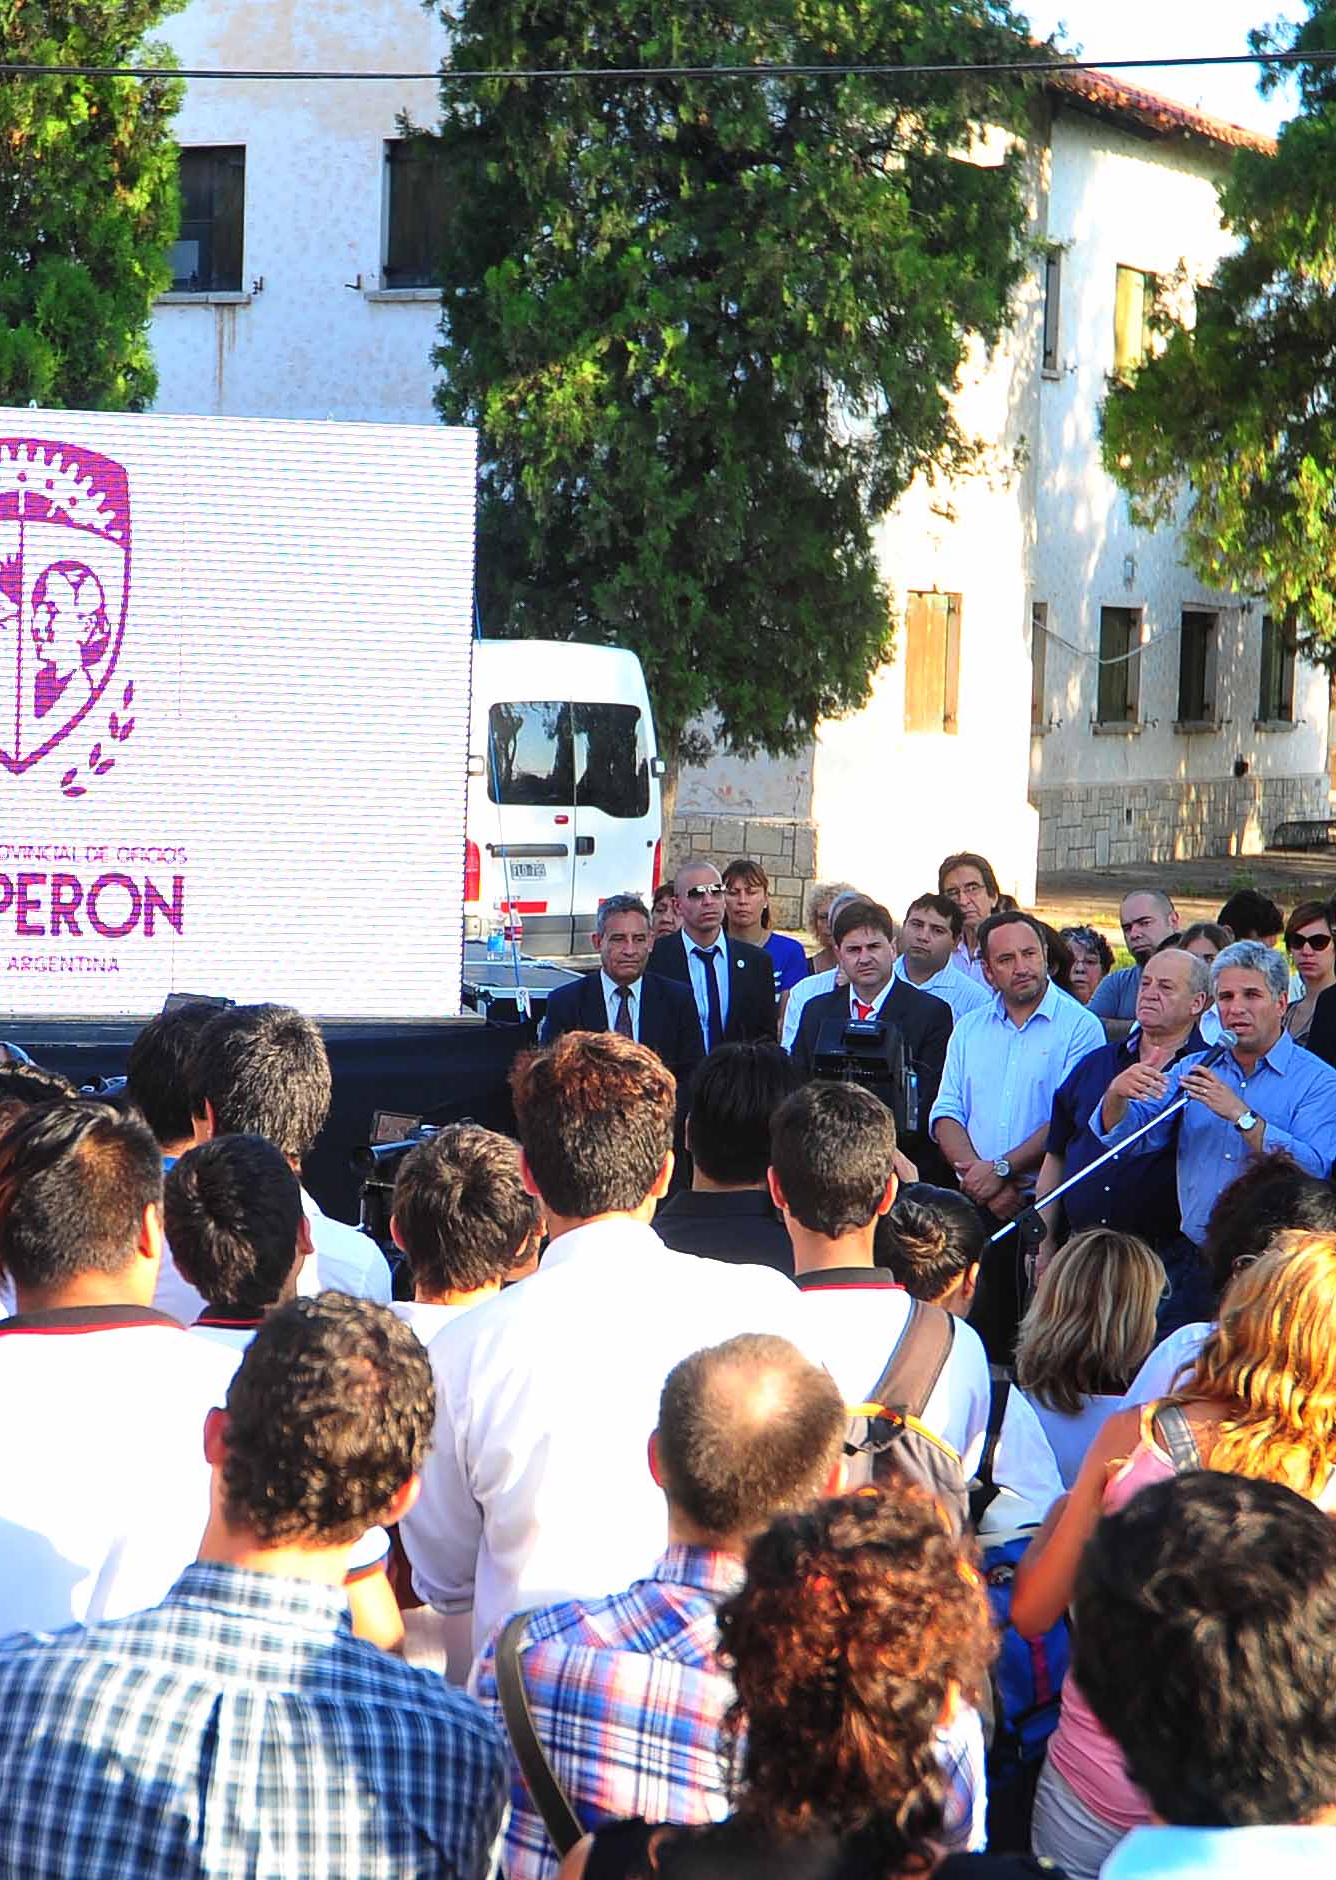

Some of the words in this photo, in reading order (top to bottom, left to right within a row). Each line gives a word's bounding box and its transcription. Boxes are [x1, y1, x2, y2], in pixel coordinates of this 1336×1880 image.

[86, 846, 110, 862] DE
[117, 846, 188, 864] OFICIOS
[6, 956, 120, 973] ARGENTINA
